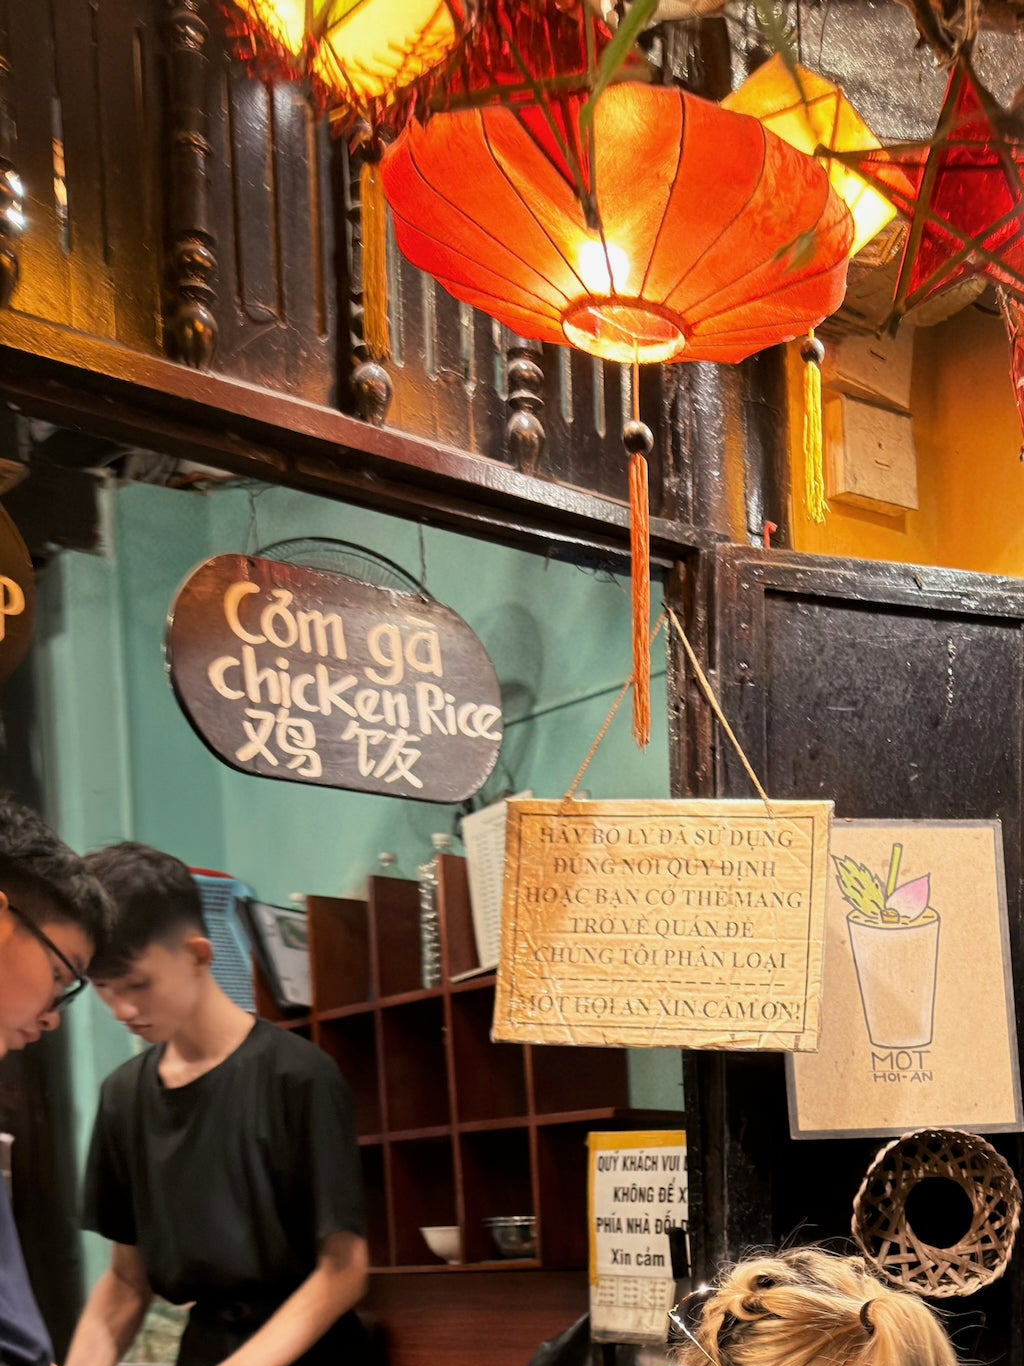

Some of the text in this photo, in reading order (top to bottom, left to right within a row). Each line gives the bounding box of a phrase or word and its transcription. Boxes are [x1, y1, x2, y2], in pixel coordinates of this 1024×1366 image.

[364, 614, 444, 686] gà
[415, 681, 503, 741] Rice
[628, 829, 653, 845] LY
[659, 825, 687, 846] ĐÃ
[731, 830, 793, 851] DỤNG
[667, 859, 714, 880] QUY
[721, 860, 776, 881] ĐỊNH
[596, 888, 639, 908] BẠN
[734, 891, 802, 909] MANG
[655, 915, 719, 938] QUÁN
[620, 943, 657, 966] TÔI
[664, 945, 724, 968] PHÂN
[733, 952, 787, 973] LOẠI
[618, 998, 651, 1016] AN
[657, 999, 697, 1018] XIN
[871, 1050, 931, 1071] MOT
[597, 1150, 619, 1173] QUÝ
[622, 1150, 659, 1172] KHÁCH
[661, 1155, 681, 1172] VUI
[613, 1182, 655, 1203] KHÔNG
[596, 1212, 623, 1234] PHÍA
[626, 1212, 651, 1235] NHÀ
[610, 1246, 666, 1268] Xin cảm
